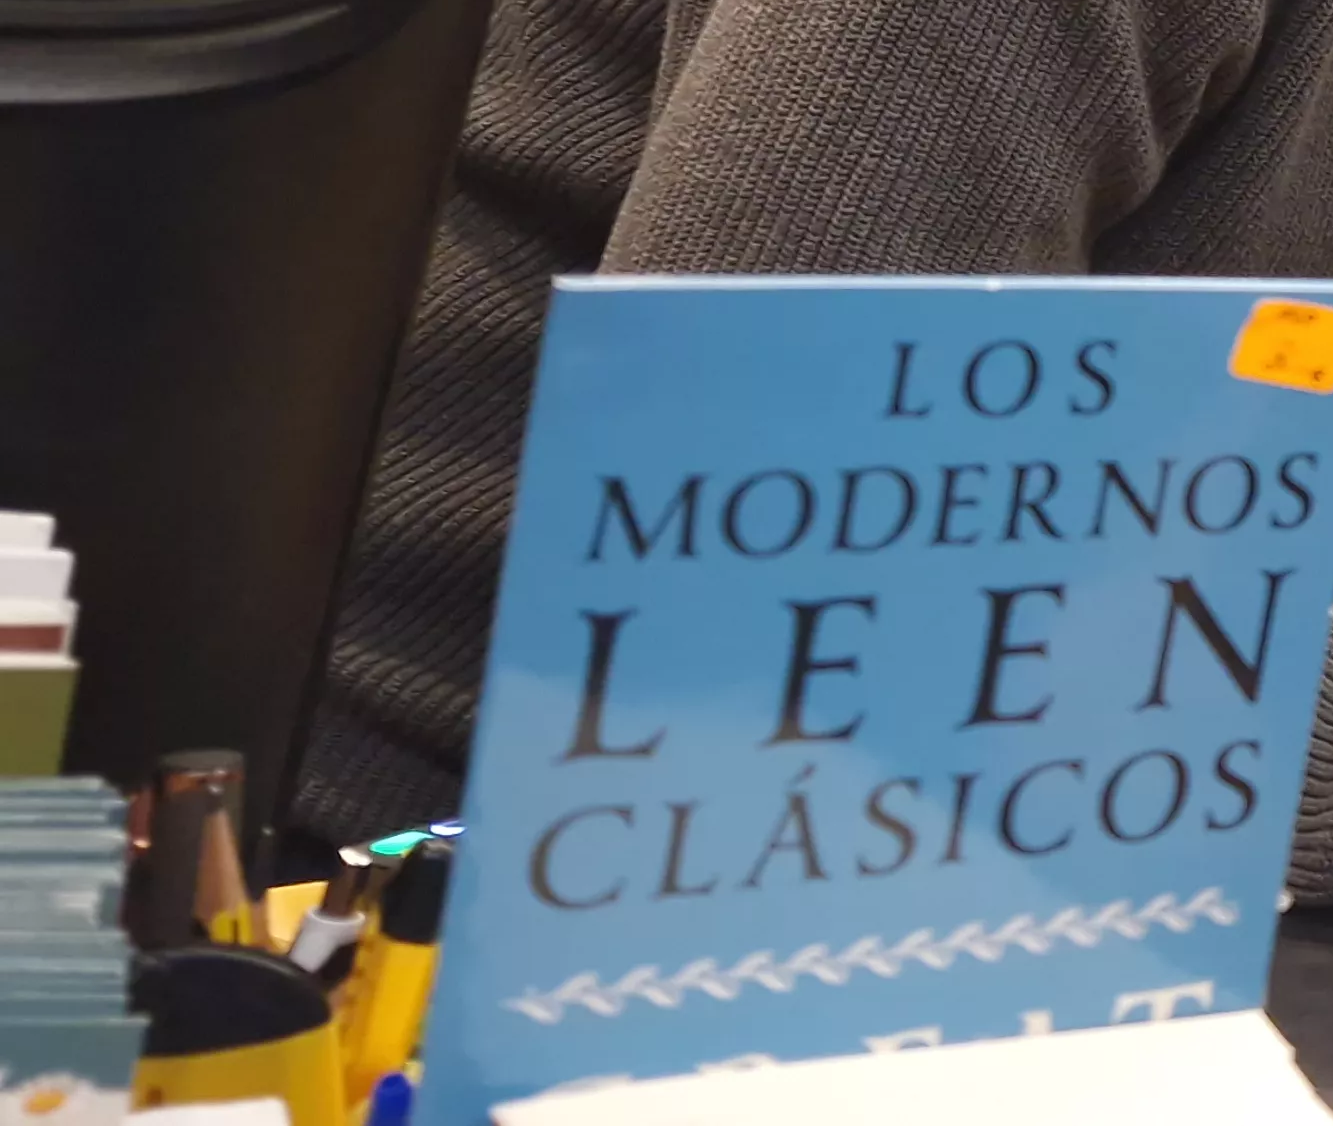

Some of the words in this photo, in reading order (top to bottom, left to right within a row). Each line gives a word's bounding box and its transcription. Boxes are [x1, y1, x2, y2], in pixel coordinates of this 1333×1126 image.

[885, 339, 1121, 418] LOS
[584, 451, 1320, 563] MODERNOS
[552, 568, 1298, 767] LEEN
[528, 739, 1263, 914] CLÁSICOS
